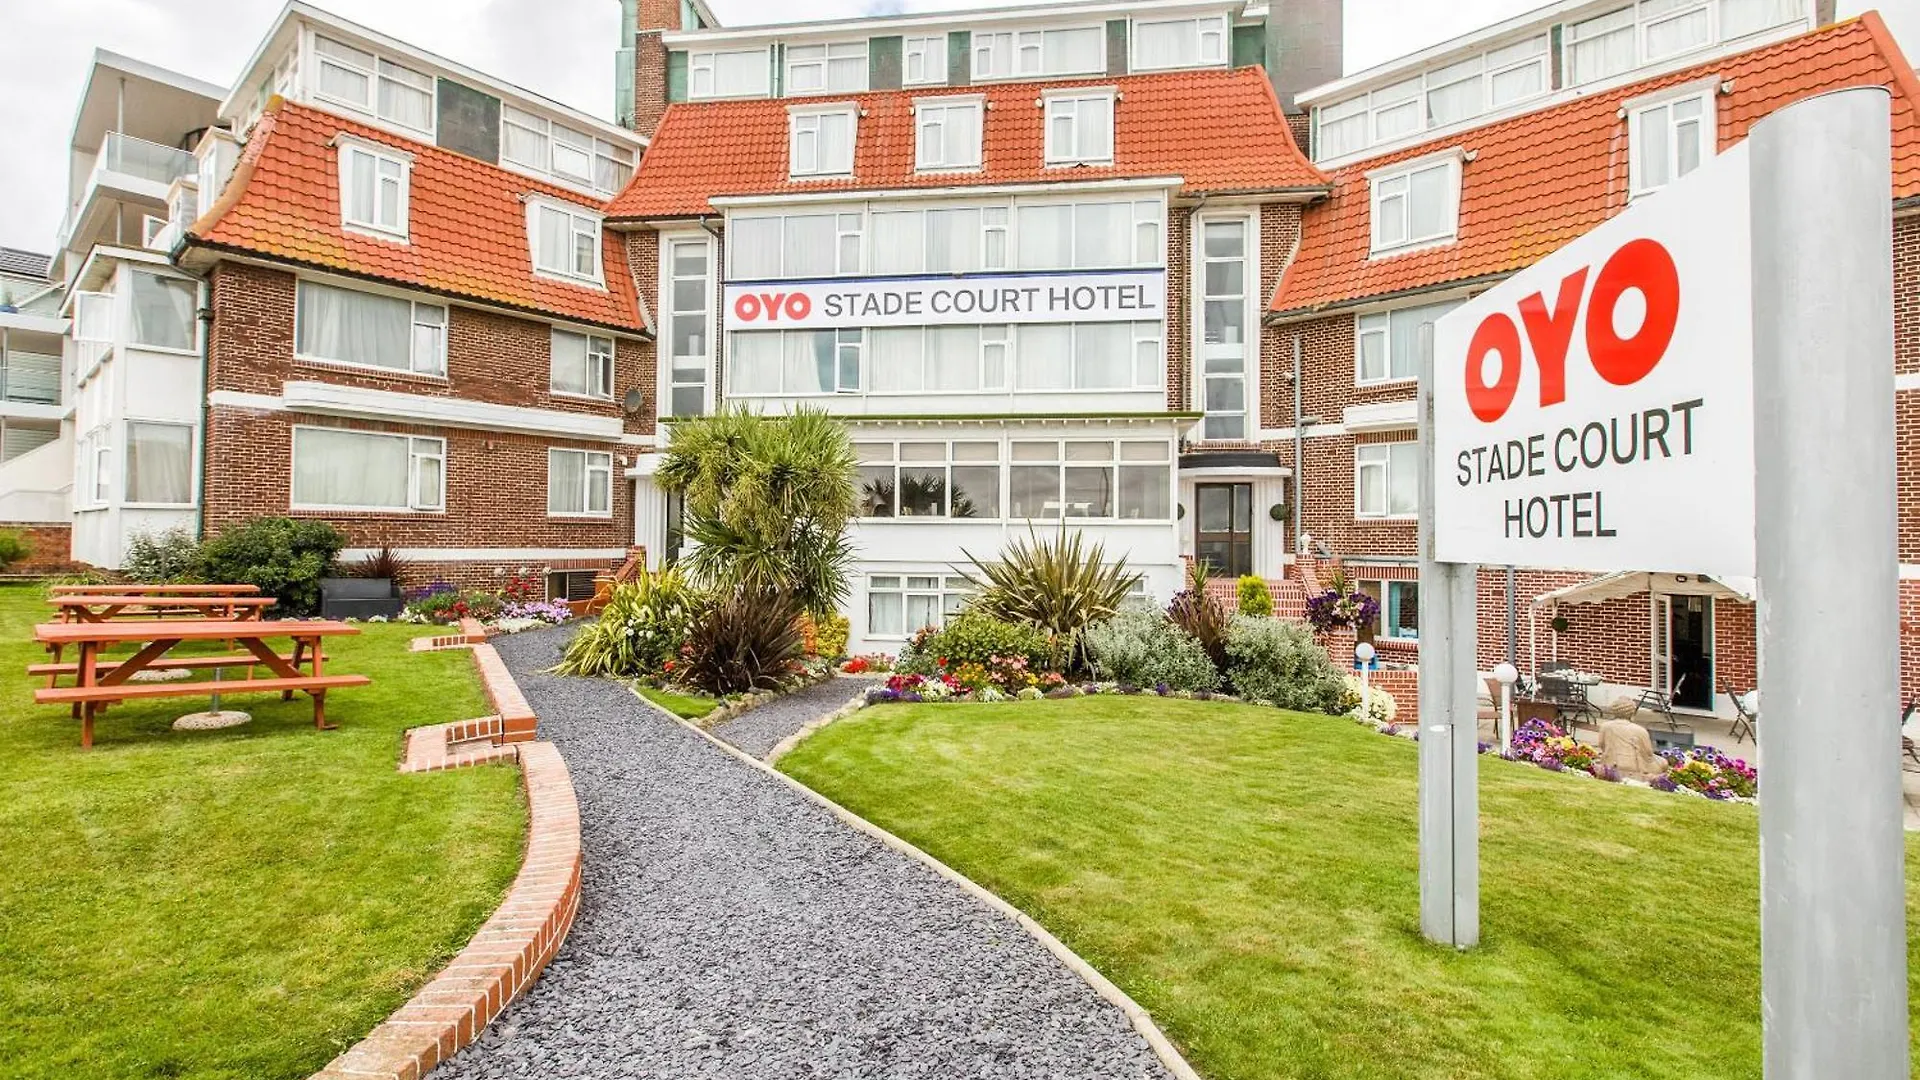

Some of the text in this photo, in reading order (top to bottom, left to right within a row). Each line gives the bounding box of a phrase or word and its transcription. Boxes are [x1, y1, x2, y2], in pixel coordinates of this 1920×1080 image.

[735, 284, 1156, 321] OYO STADE COURT HOTEL
[1465, 238, 1680, 423] OYO
[1457, 397, 1704, 487] STADE COURT
[1504, 491, 1617, 539] HOTEL
